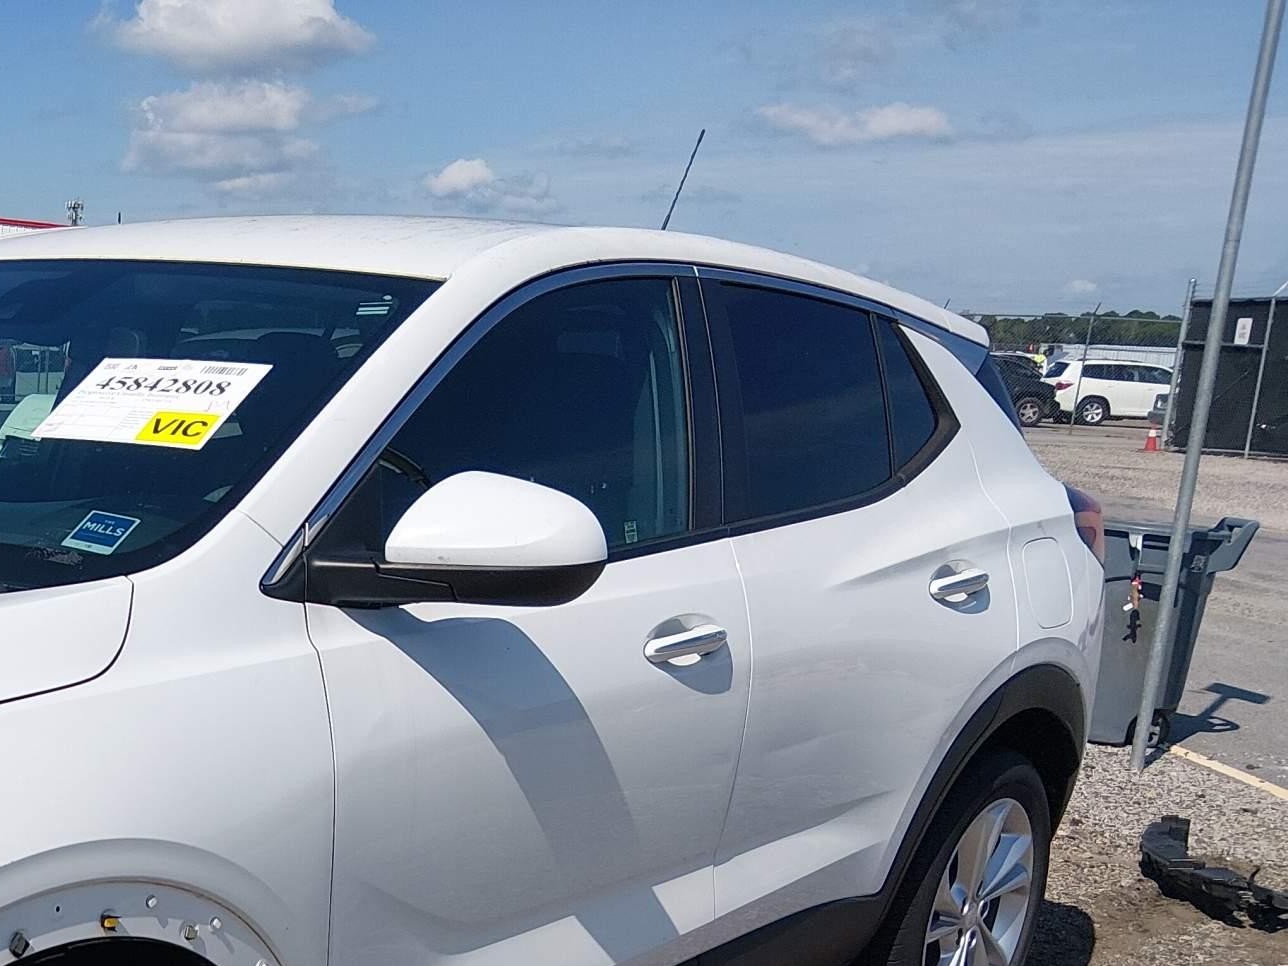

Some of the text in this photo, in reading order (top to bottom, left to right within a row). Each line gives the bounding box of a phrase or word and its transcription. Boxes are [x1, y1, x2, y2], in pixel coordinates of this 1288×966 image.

[96, 376, 231, 396] 45842808
[152, 418, 208, 437] VIC
[82, 521, 125, 536] MILLS
